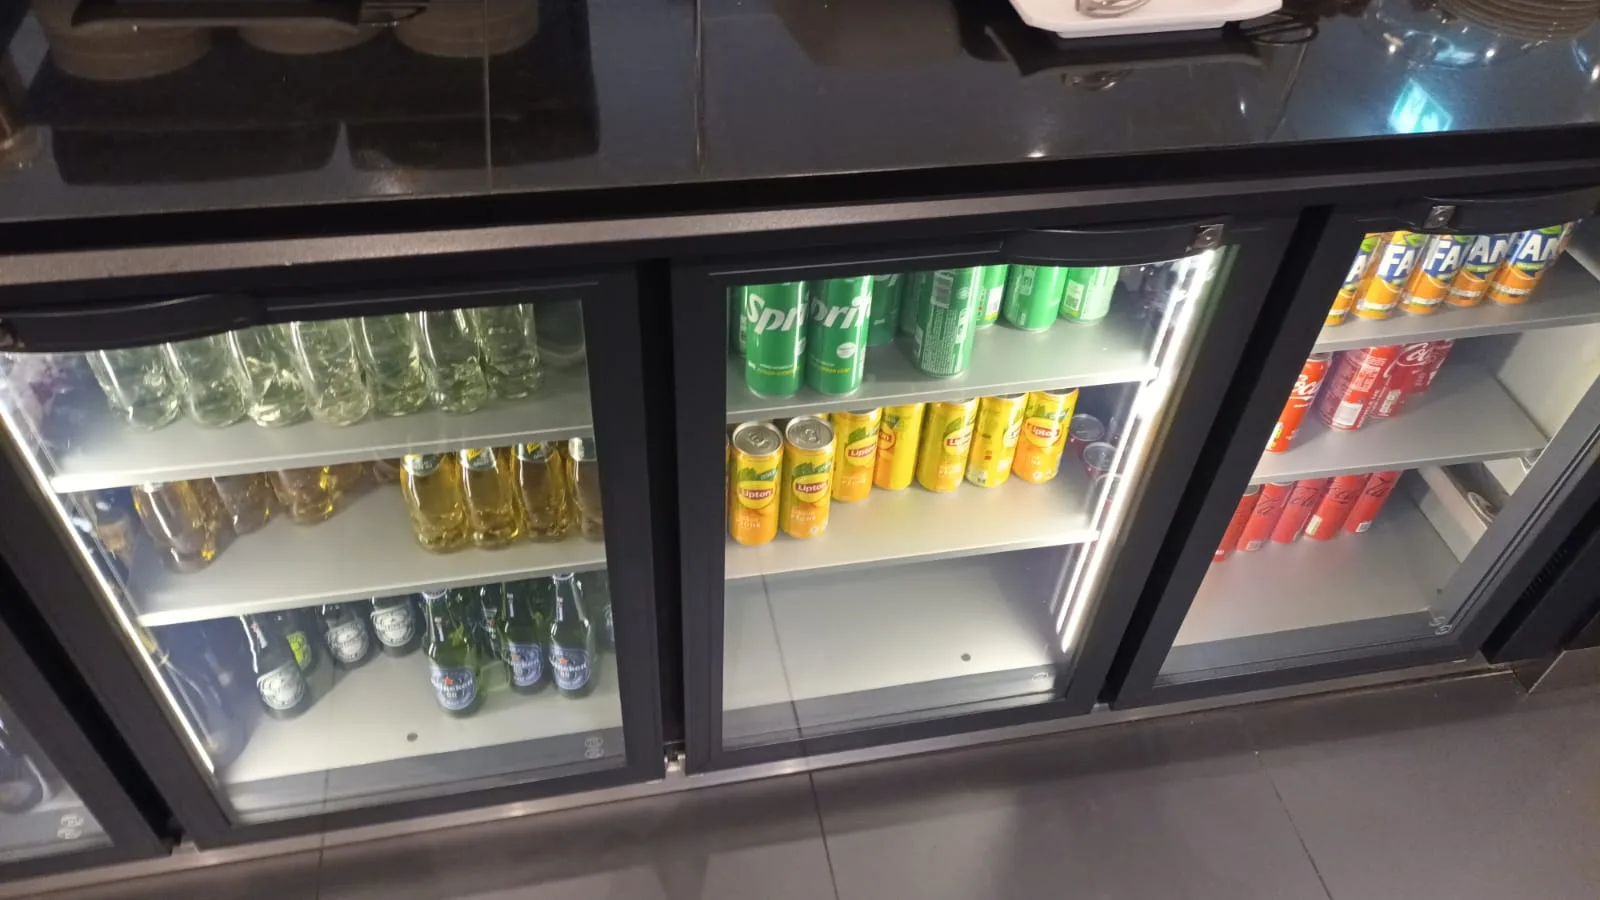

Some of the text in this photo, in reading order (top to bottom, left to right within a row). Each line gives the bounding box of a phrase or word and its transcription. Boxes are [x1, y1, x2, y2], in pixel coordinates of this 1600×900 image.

[1377, 244, 1415, 277] FA
[1422, 237, 1461, 272] FA
[740, 488, 775, 500] Lipton
[795, 482, 828, 494] Lipton
